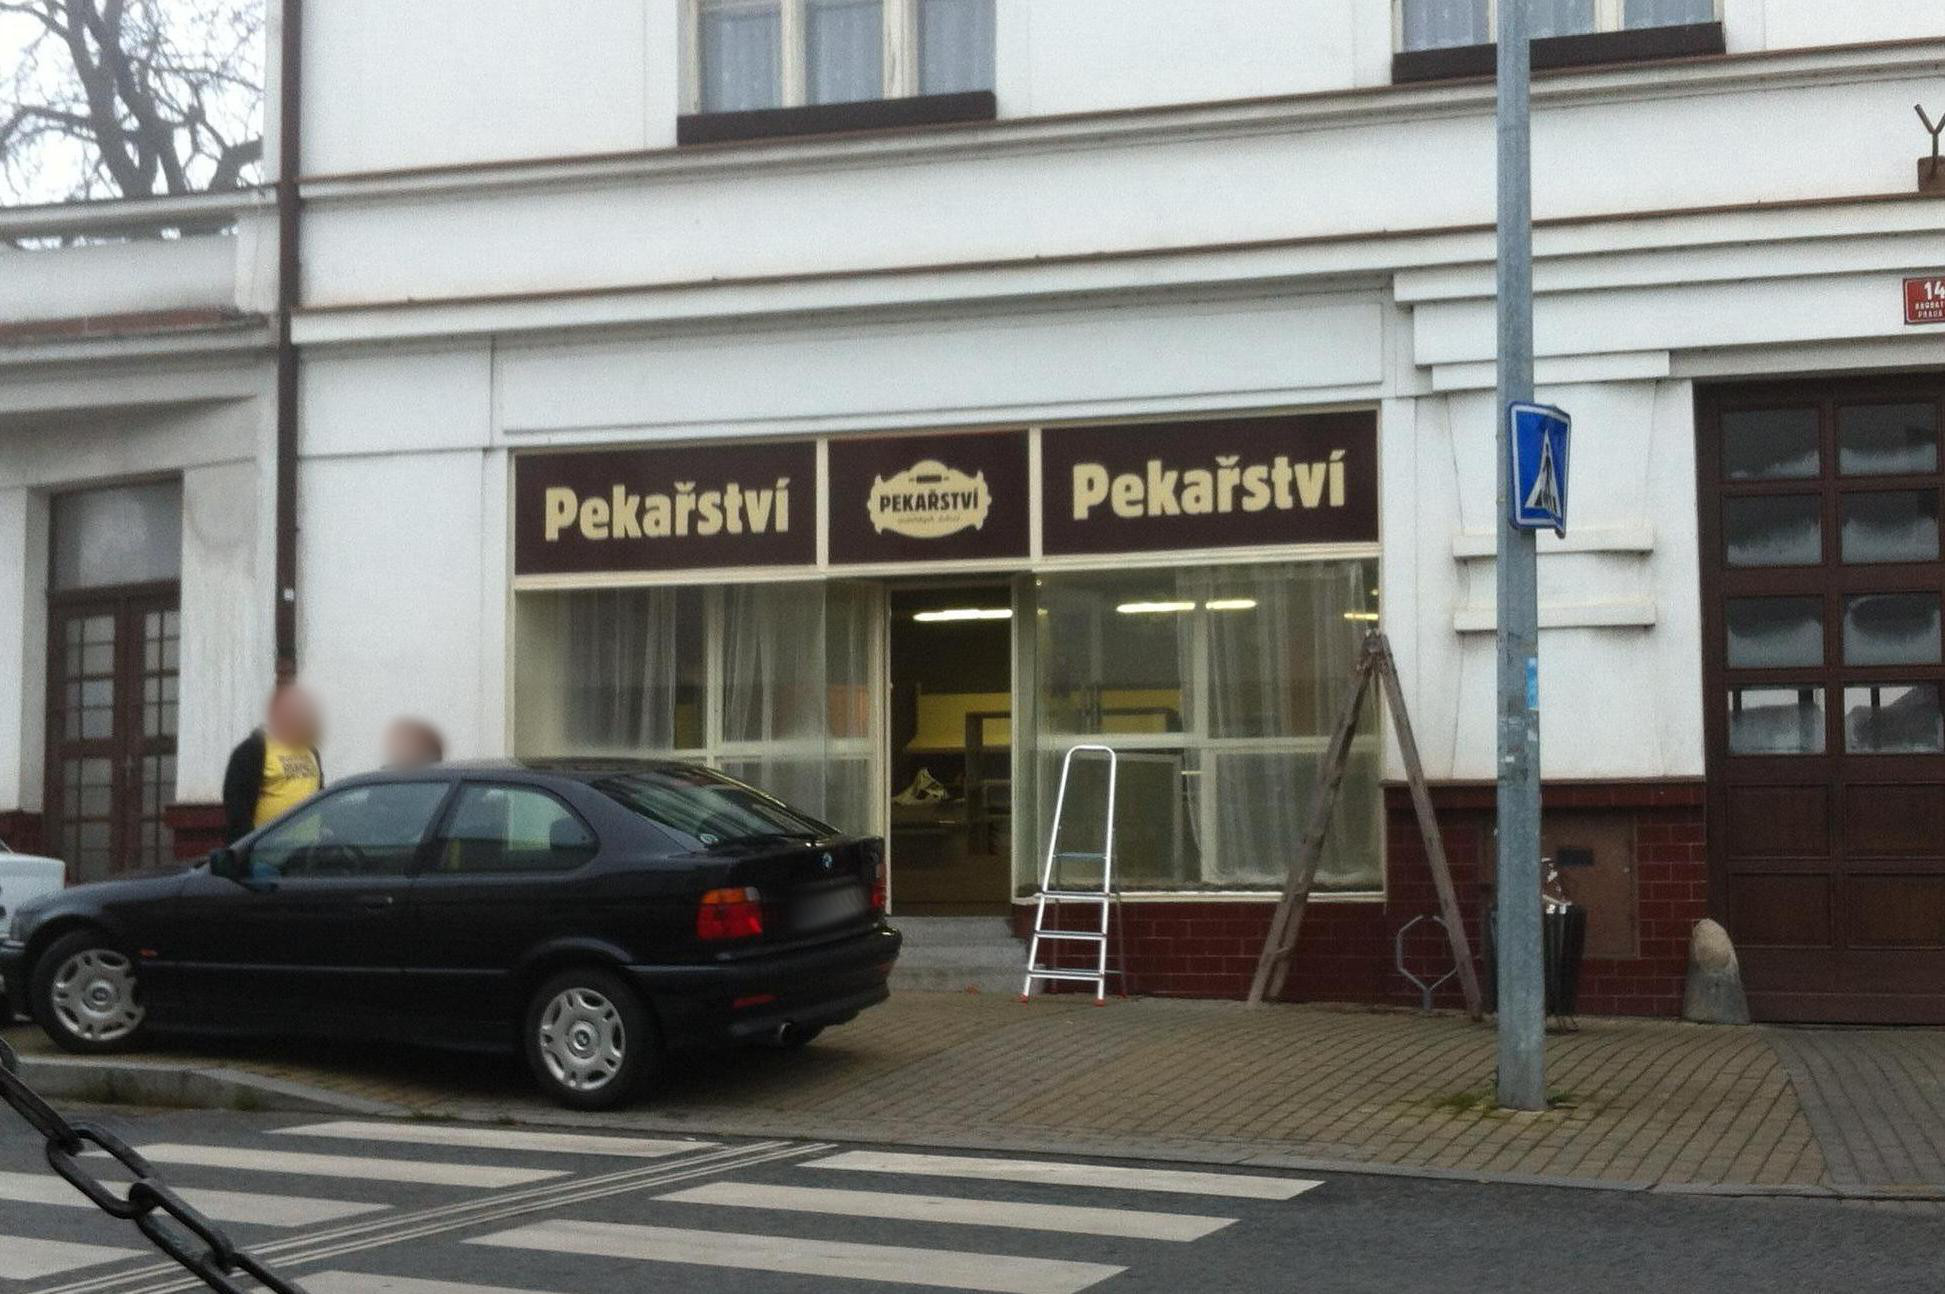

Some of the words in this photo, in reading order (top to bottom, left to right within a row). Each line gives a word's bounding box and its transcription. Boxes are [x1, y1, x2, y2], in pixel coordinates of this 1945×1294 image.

[545, 477, 790, 541] Pekařství
[879, 488, 979, 513] PEKAŘSTVÍ
[1073, 450, 1346, 520] Pekařství
